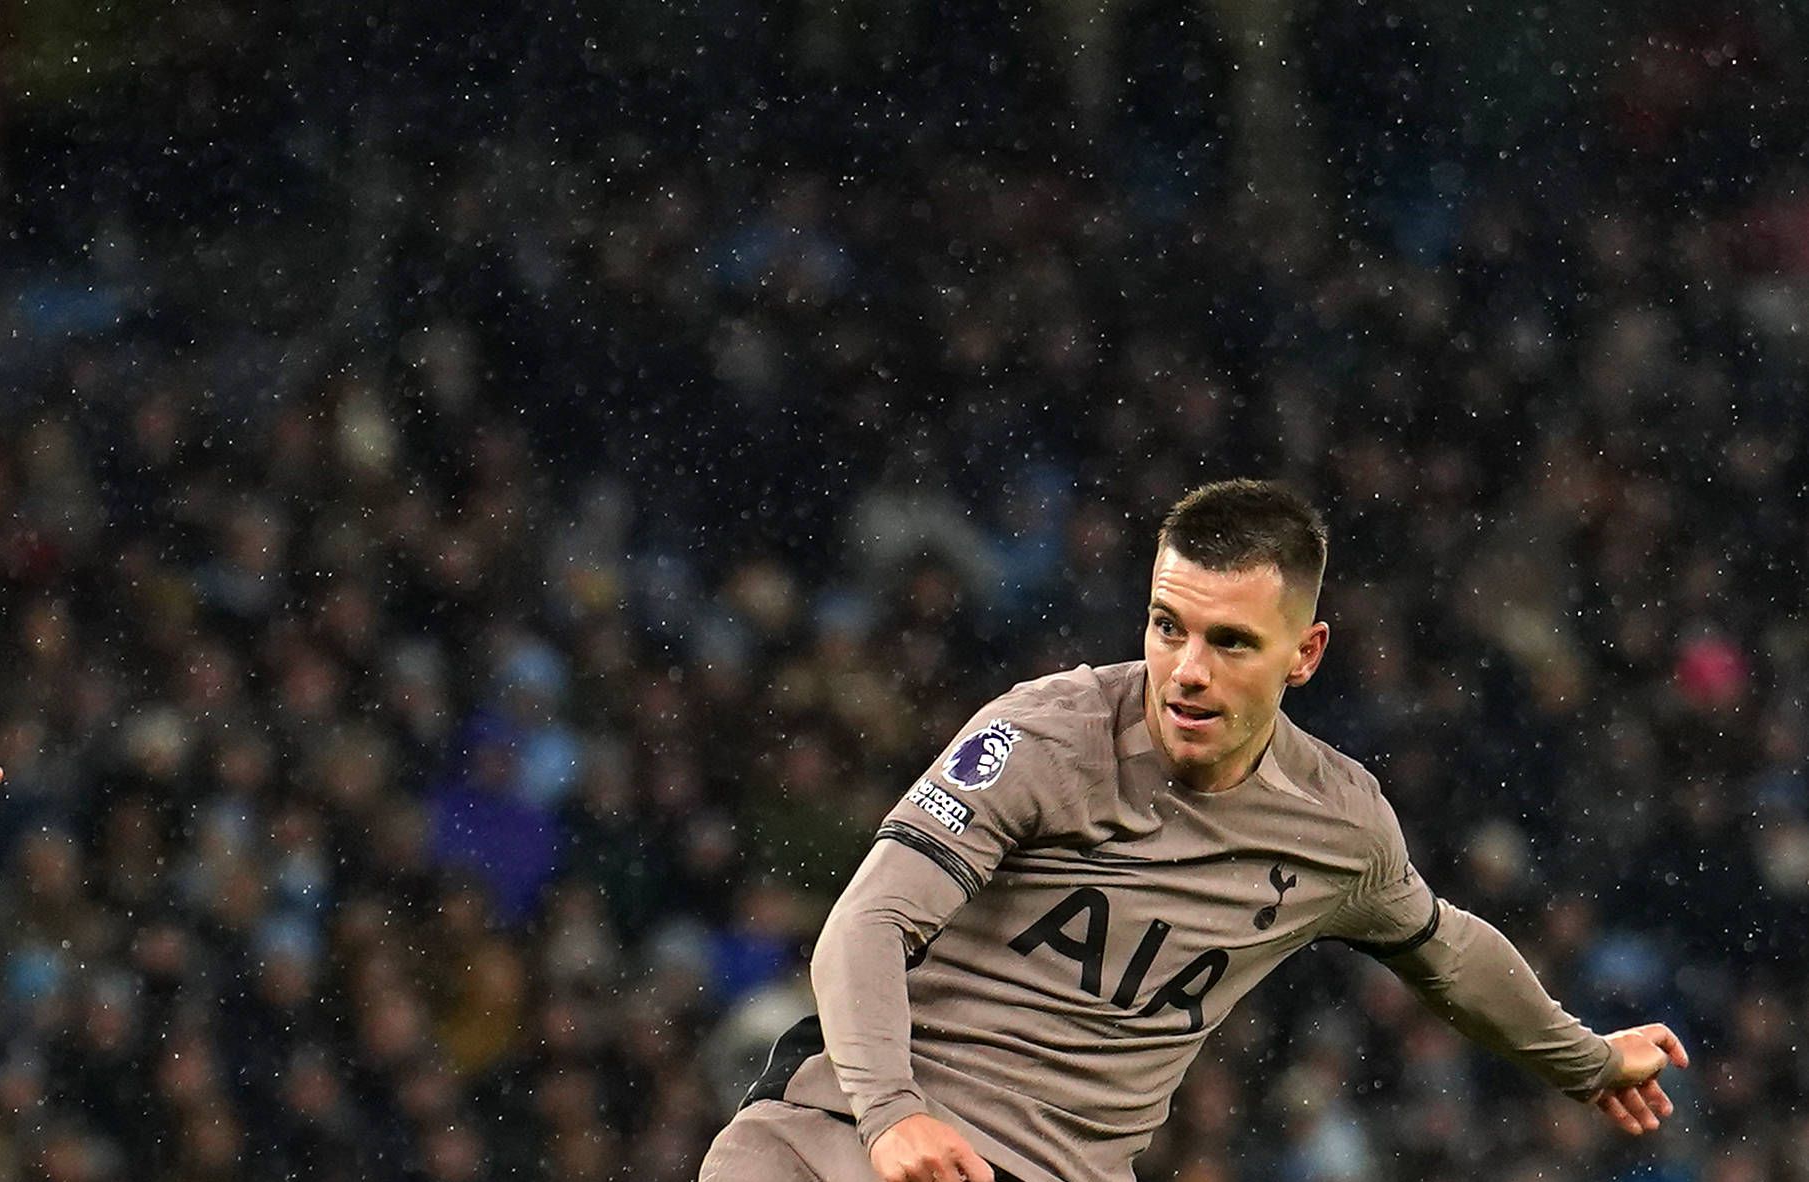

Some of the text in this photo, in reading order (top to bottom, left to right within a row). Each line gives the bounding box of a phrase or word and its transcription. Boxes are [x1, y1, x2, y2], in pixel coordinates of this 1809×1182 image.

[919, 797, 965, 836] racism
[931, 787, 968, 820] room
[1007, 887, 1229, 1034] AIA
